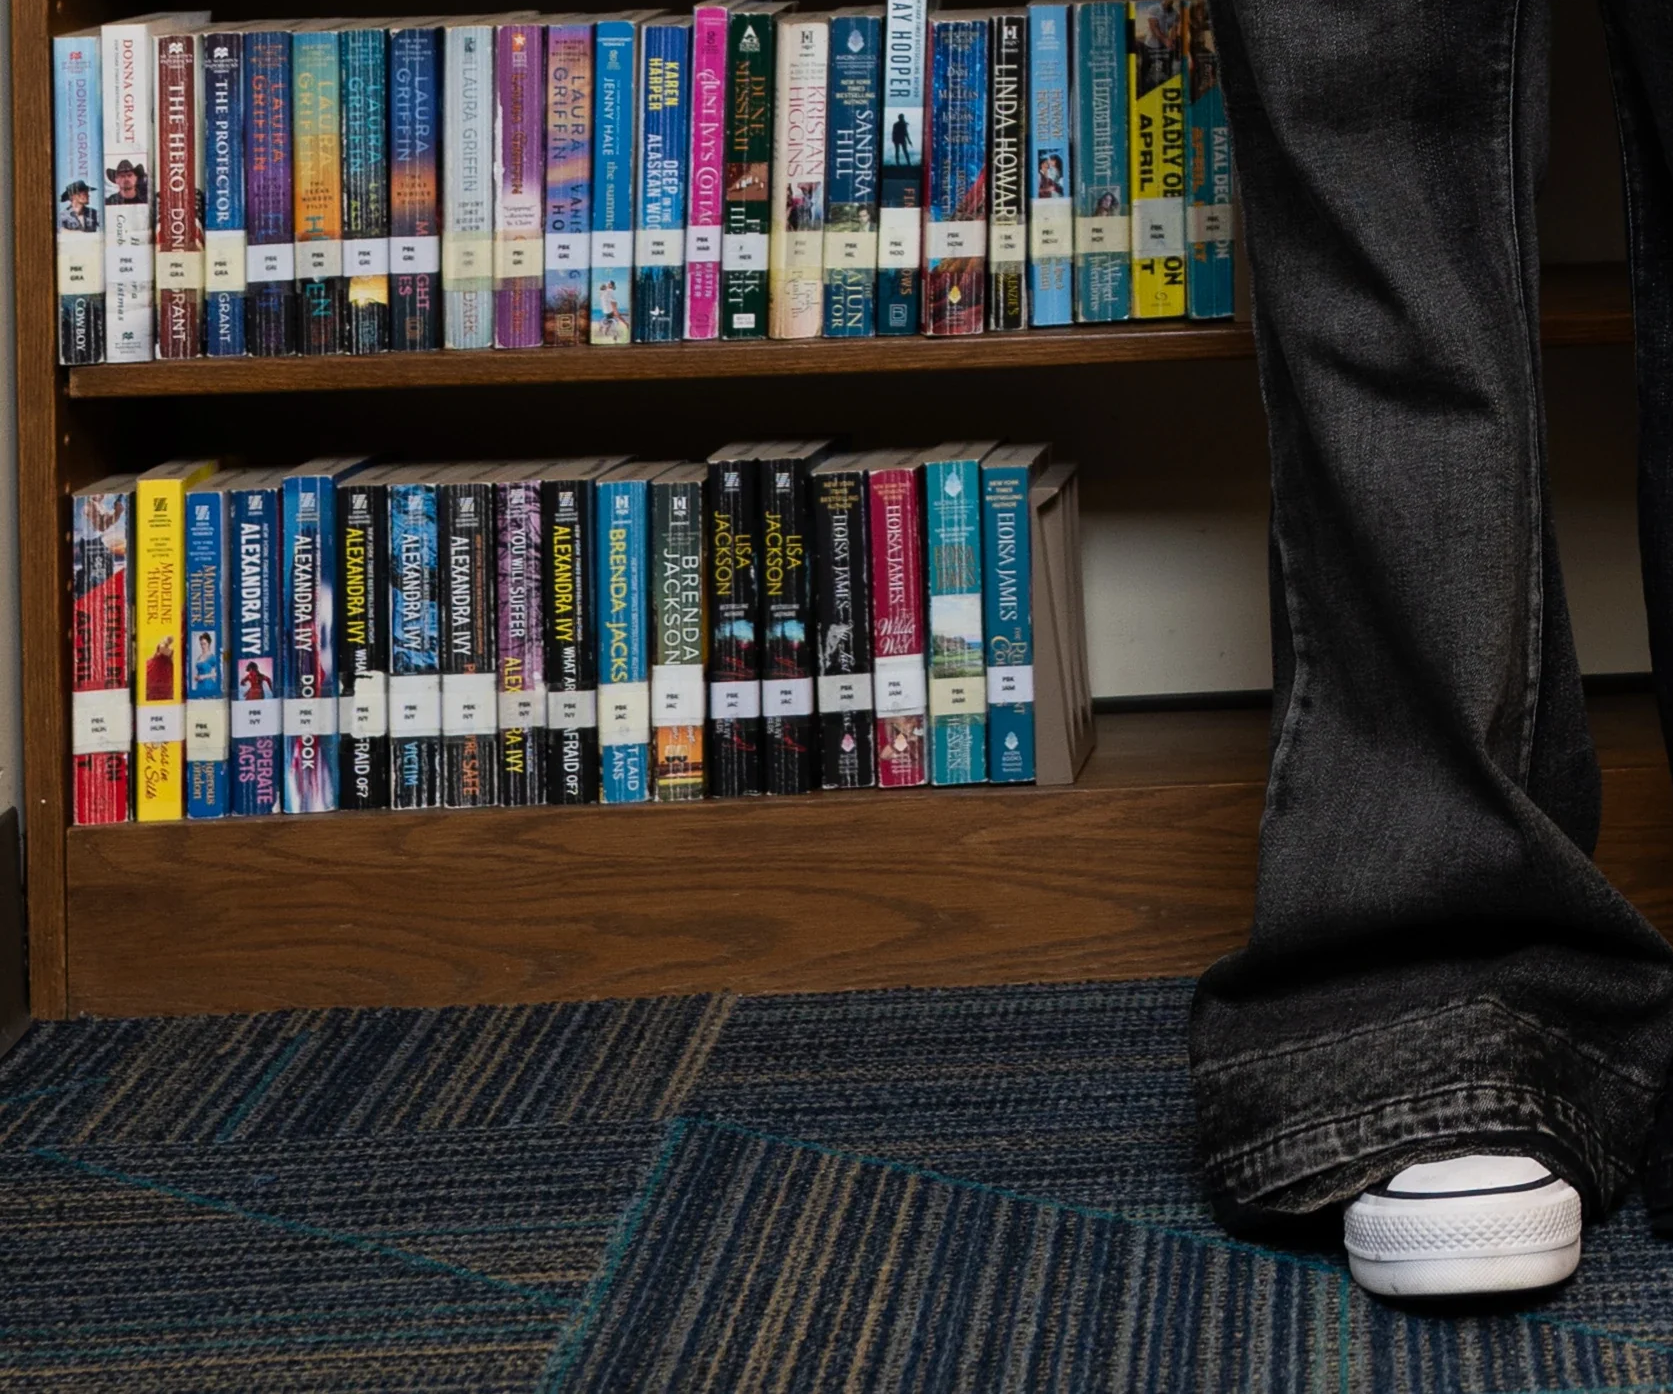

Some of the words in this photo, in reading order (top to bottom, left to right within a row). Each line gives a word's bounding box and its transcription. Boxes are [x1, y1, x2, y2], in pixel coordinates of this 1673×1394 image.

[649, 58, 664, 110] HARPER
[665, 62, 678, 105] KAREN
[890, 30, 912, 97] HOOPER
[76, 79, 88, 127] DONNA
[216, 79, 227, 114] THE
[77, 133, 89, 177] GRANT
[216, 119, 230, 223] PROTECTOR
[837, 129, 852, 179] HILL
[855, 110, 874, 196] SANDRA
[219, 292, 230, 342] GRANT
[766, 511, 782, 595] JACKSON
[786, 535, 802, 569] LISA
[997, 513, 1016, 563] ELOISA
[160, 562, 172, 624] MADELINE
[241, 523, 260, 623] ALEXANDRA
[997, 569, 1017, 620] JAMES
[663, 549, 680, 665] JACKSON
[682, 556, 698, 660] BRENDA
[242, 628, 260, 654] IVY
